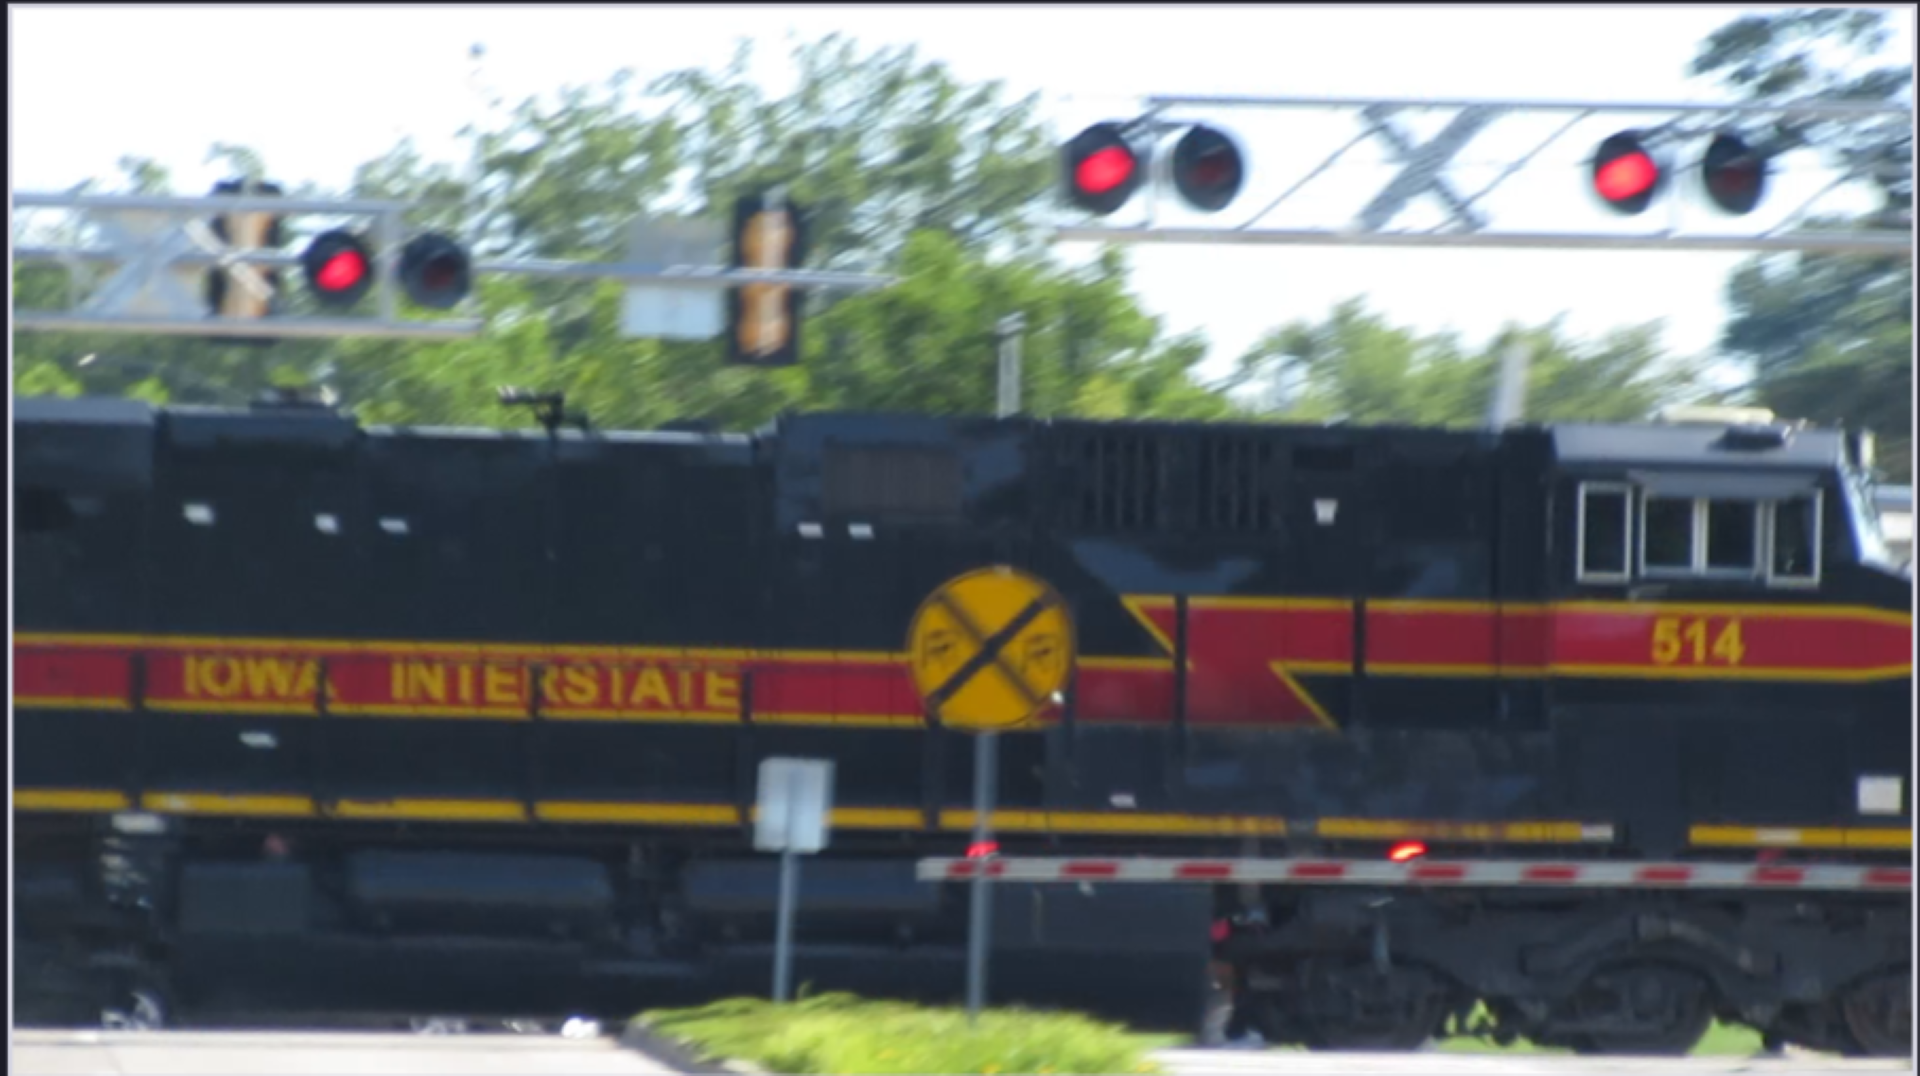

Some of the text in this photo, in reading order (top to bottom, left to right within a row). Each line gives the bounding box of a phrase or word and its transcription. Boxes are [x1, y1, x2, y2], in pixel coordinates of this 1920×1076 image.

[1652, 616, 1745, 664] 514
[184, 656, 741, 709] IOWA INTERSTATE
